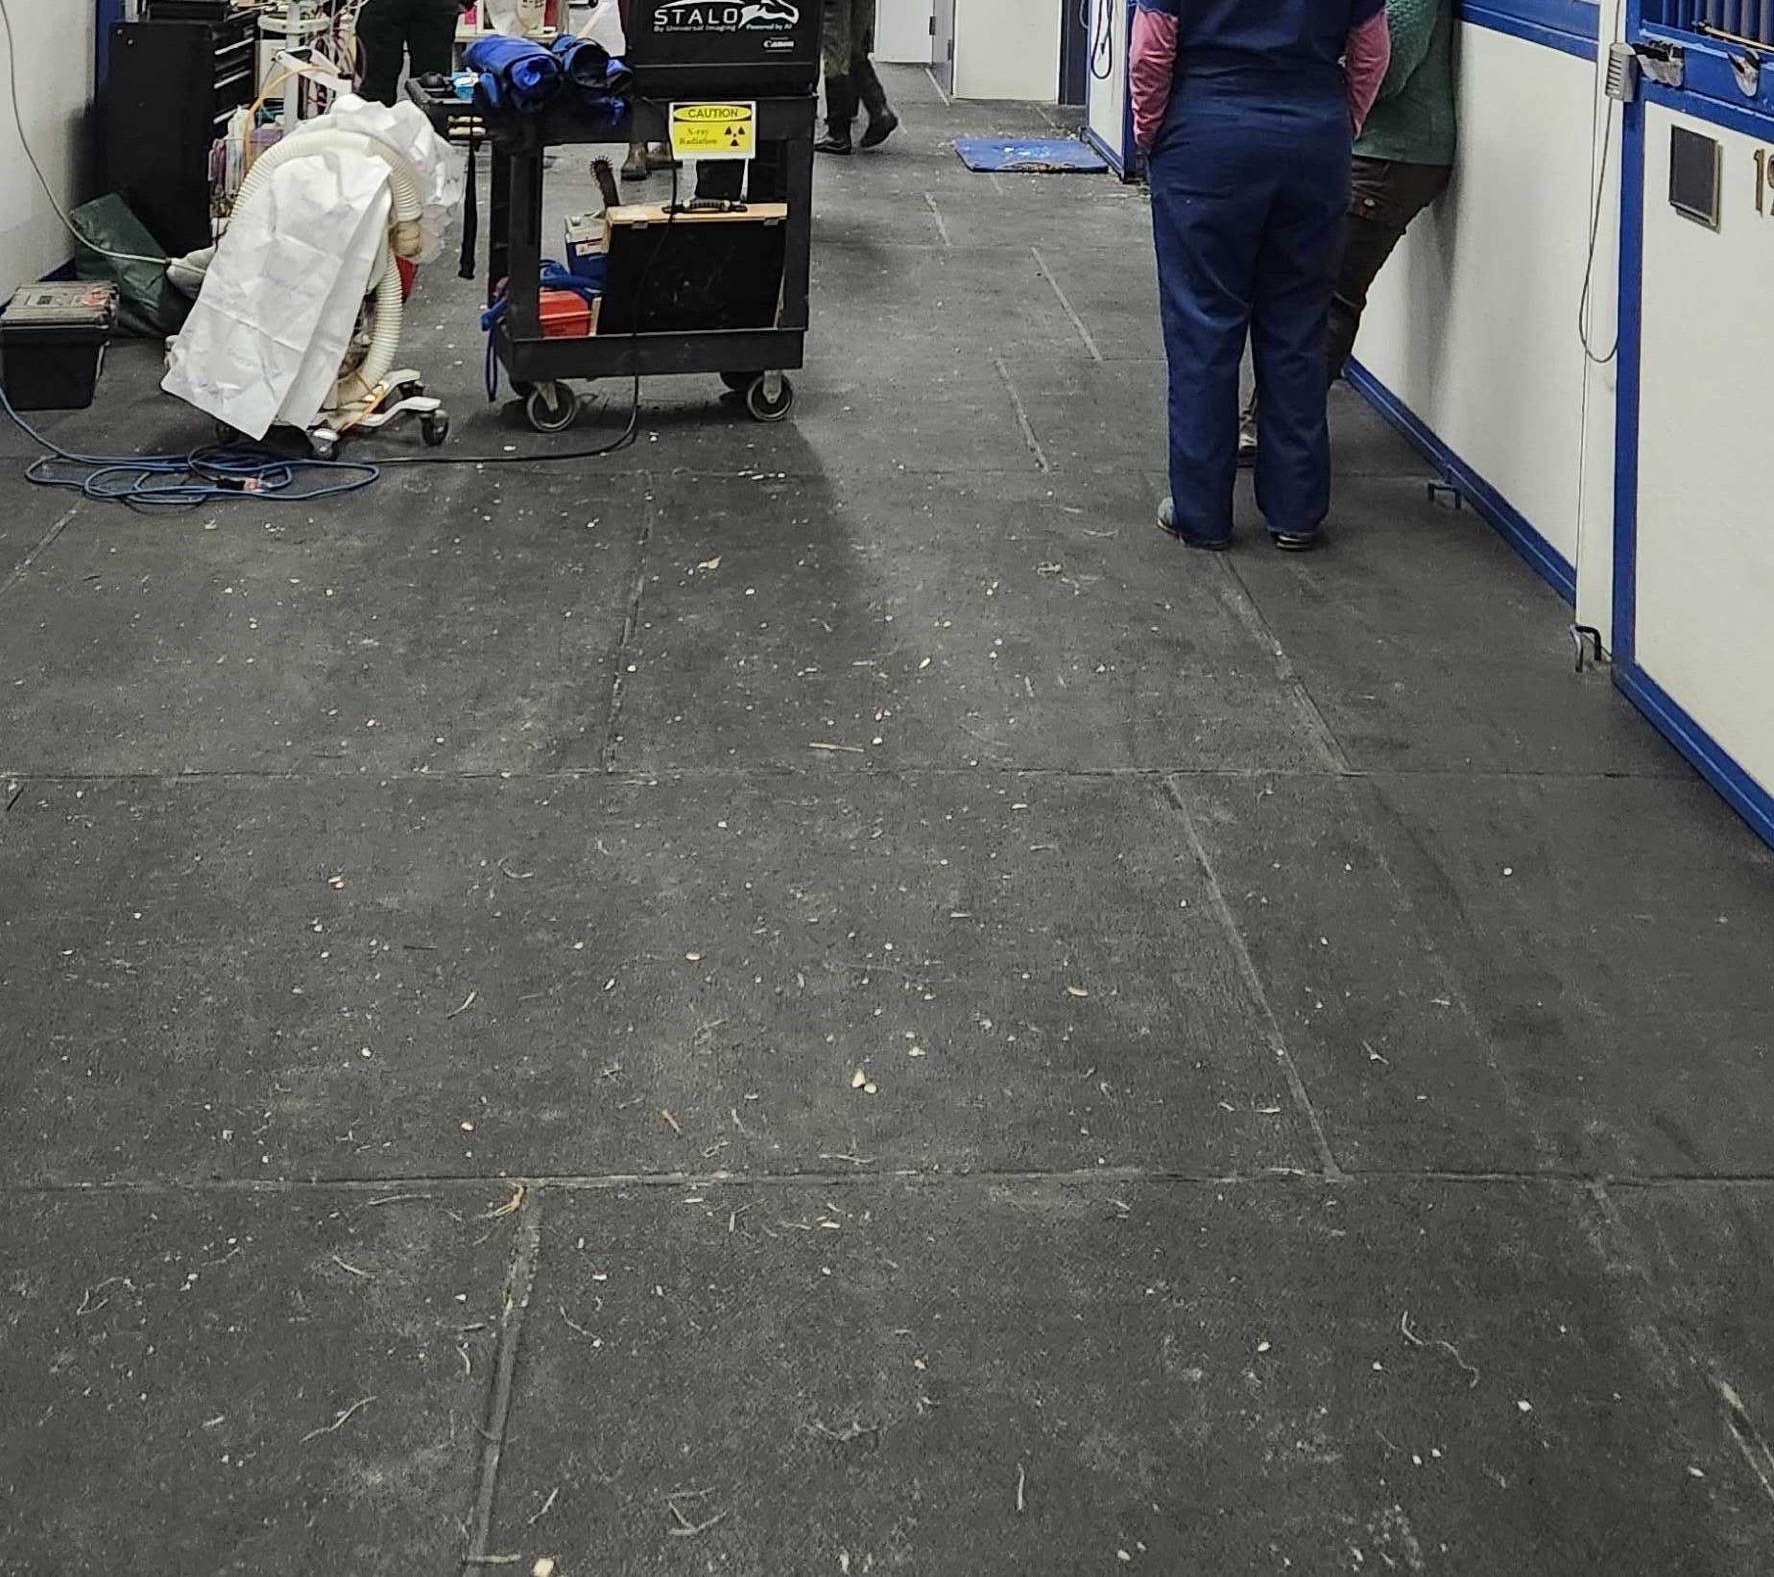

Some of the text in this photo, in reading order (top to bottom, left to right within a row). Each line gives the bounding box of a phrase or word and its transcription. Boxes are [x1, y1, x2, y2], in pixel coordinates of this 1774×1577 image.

[654, 8, 738, 25] STALO
[763, 40, 795, 48] Canon
[688, 108, 738, 118] CAUTION
[687, 127, 708, 137] X-ray
